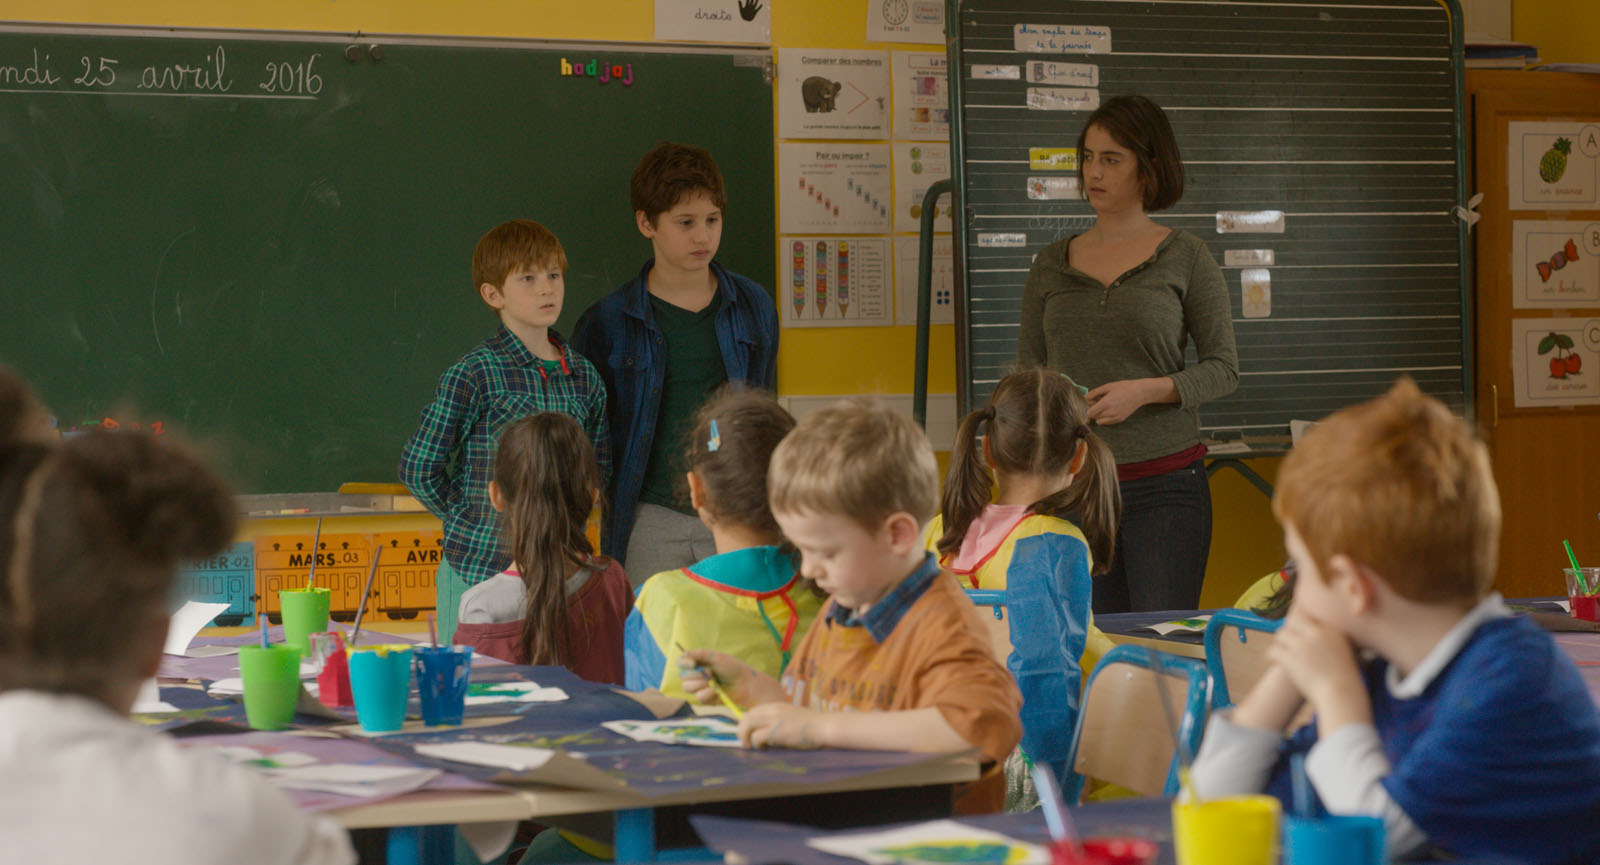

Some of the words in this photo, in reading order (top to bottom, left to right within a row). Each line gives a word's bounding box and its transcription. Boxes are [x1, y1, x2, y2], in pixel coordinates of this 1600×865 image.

[801, 56, 837, 66] Comparer
[839, 57, 851, 65] des
[853, 58, 882, 66] nombres
[930, 58, 939, 66] La
[74, 56, 119, 87] 25
[137, 45, 233, 92] avril
[260, 54, 322, 94] 2016
[1586, 132, 1598, 149] A
[816, 151, 830, 160] Pair
[842, 151, 864, 161] impair
[1592, 231, 1600, 247] B
